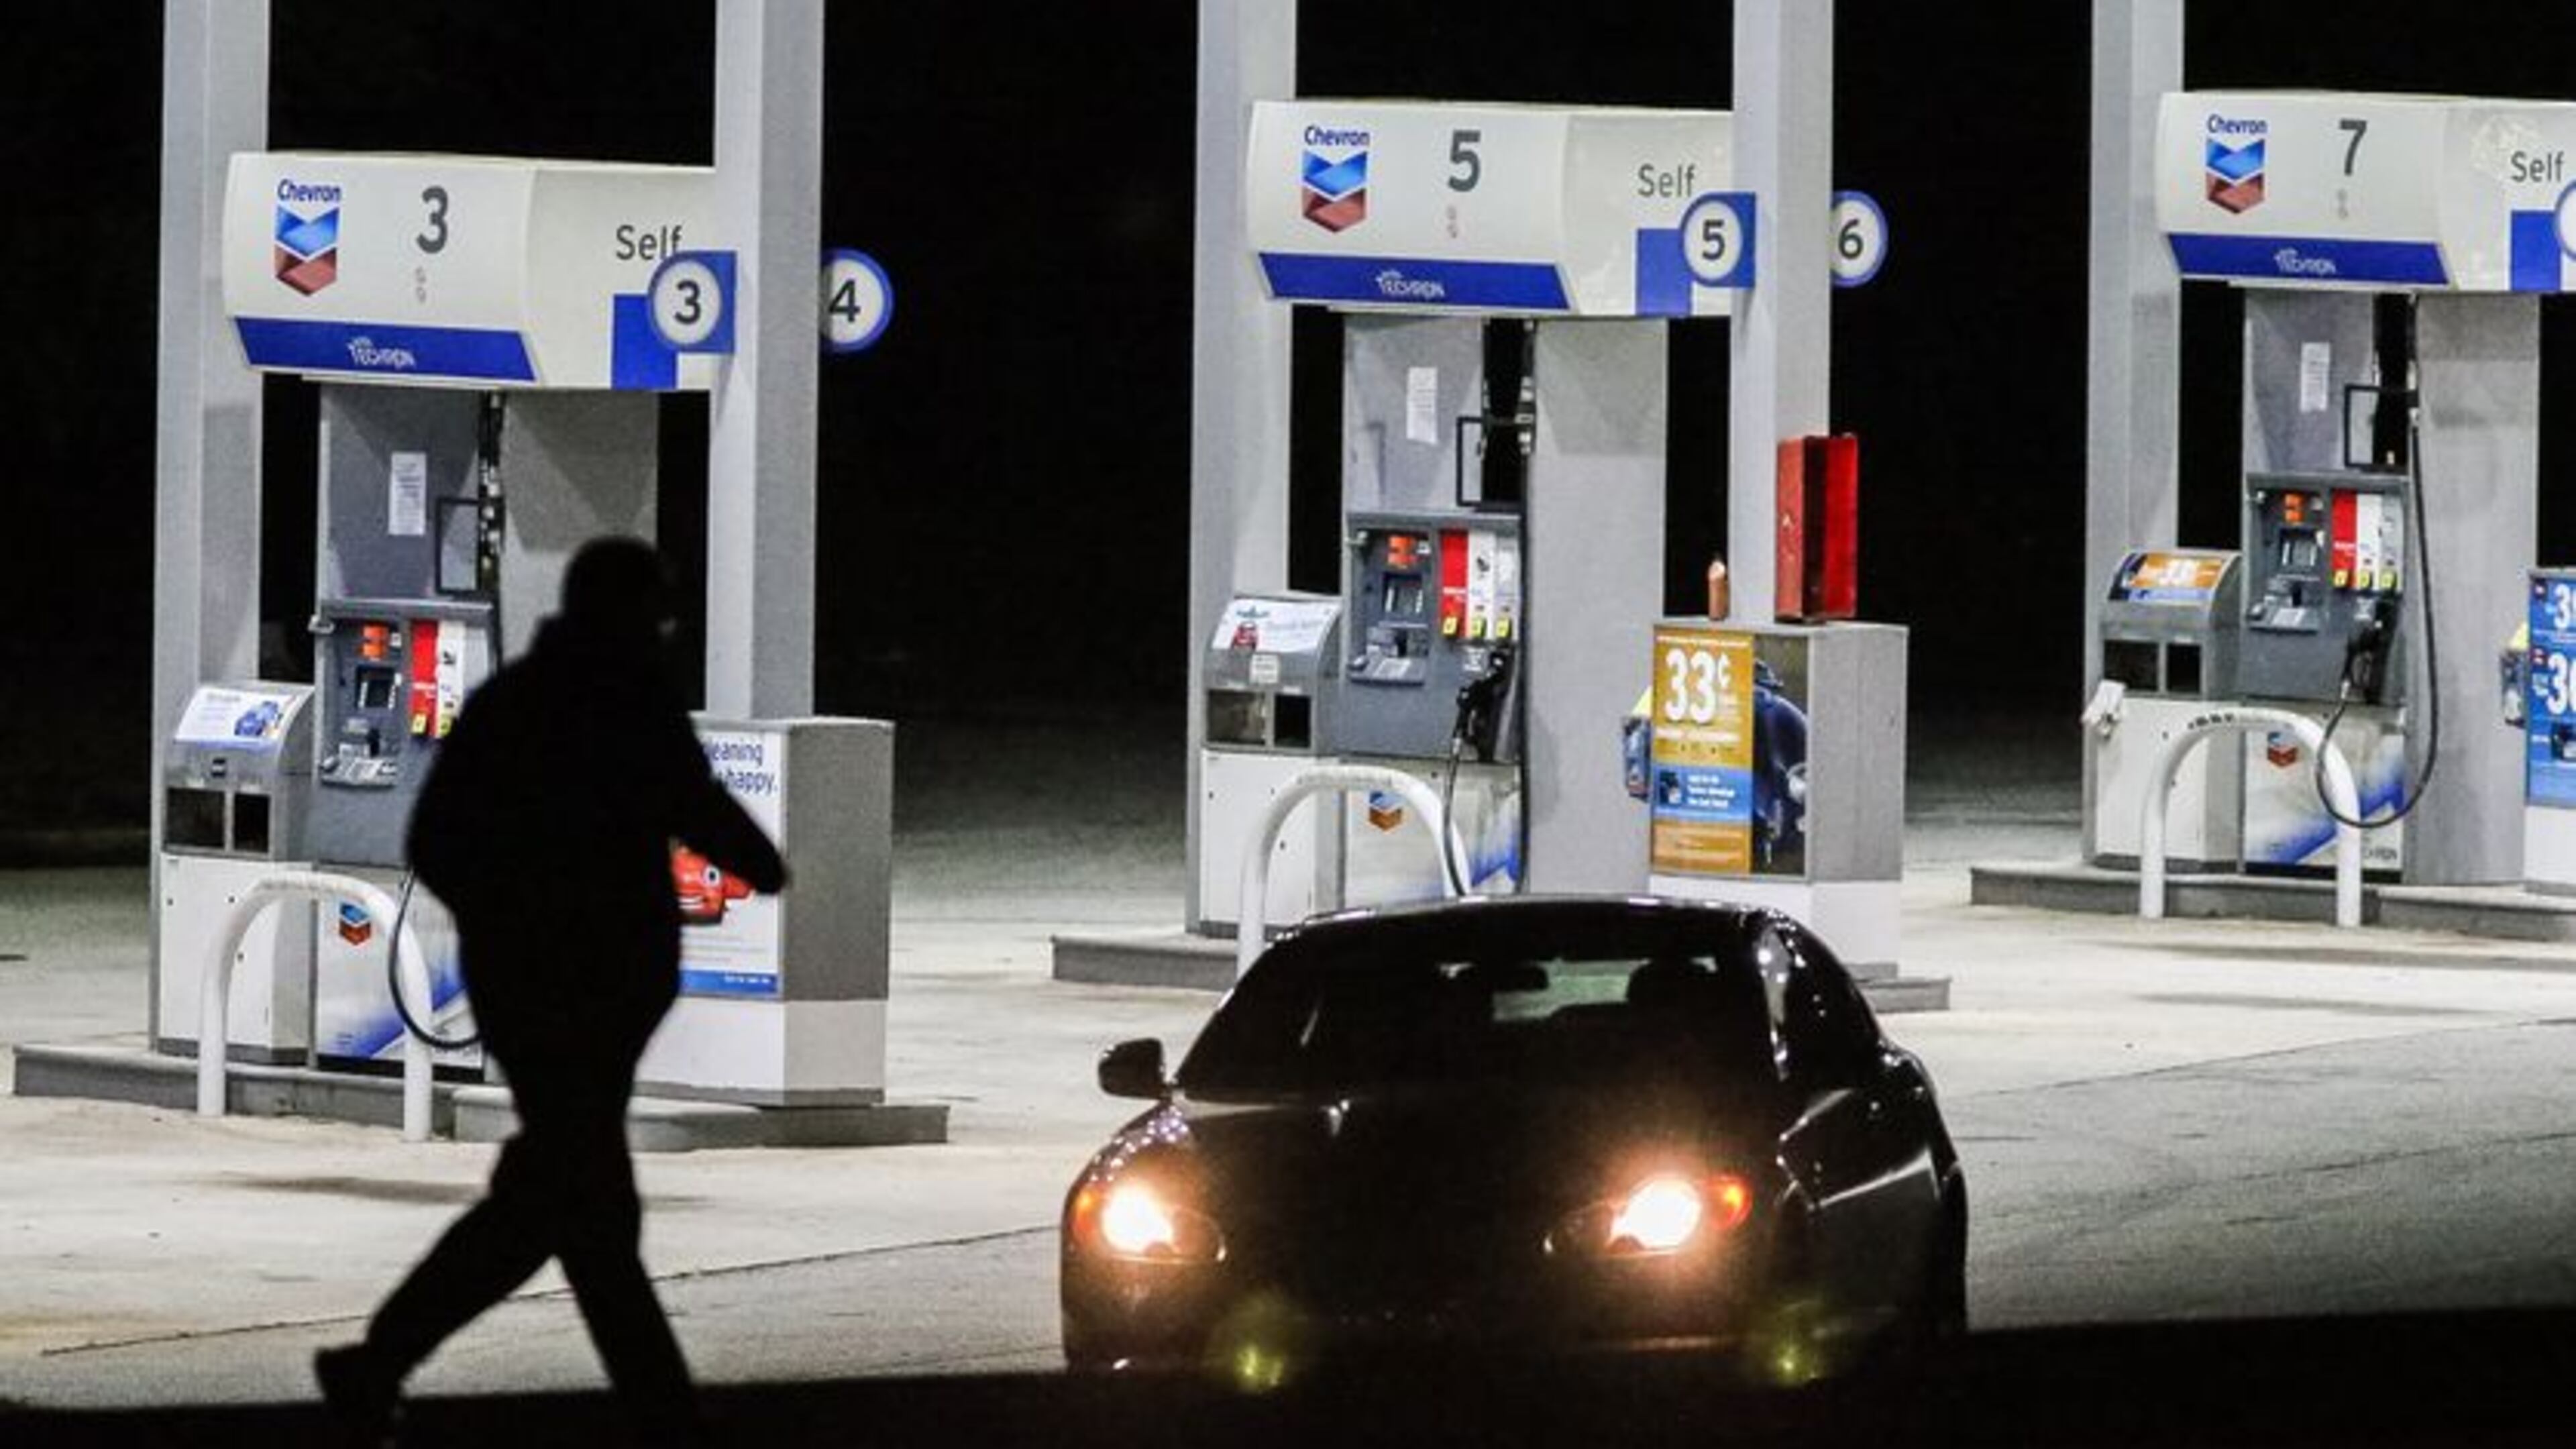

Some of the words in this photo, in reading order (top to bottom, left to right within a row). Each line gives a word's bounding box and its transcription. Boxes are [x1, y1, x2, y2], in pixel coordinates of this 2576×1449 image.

[1303, 125, 1371, 146] Chevron
[2207, 114, 2267, 134] Chevron
[1448, 130, 1483, 193] 5
[2339, 119, 2367, 176] 7
[2510, 151, 2565, 182] Self
[277, 179, 341, 202] Chevron
[1638, 164, 1696, 199] Self
[416, 186, 449, 254] 3
[1701, 219, 1726, 260] 5
[1837, 219, 1864, 260] 6
[615, 224, 684, 261] Self
[674, 280, 702, 325] 3
[828, 279, 861, 323] 4
